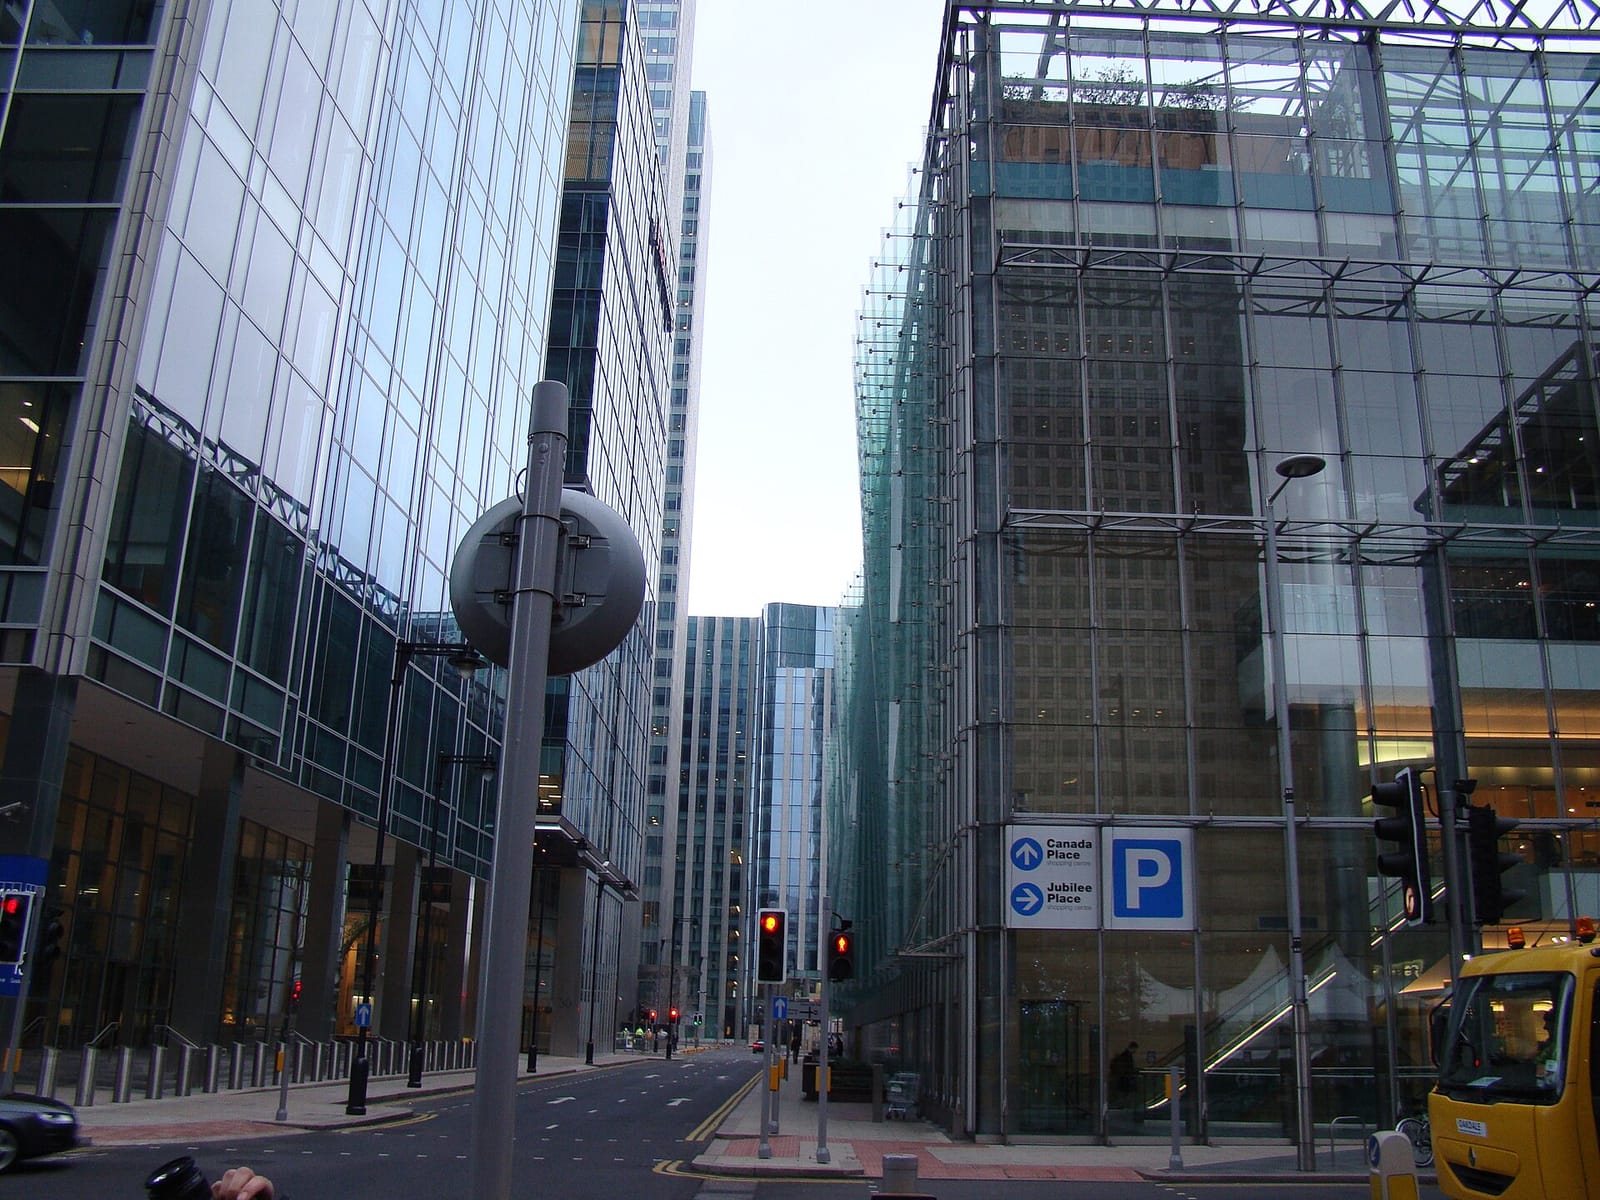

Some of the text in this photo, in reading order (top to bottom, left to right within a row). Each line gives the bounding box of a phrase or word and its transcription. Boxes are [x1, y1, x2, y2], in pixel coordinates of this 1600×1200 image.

[1046, 839, 1092, 849] Canada
[1047, 850, 1081, 859] Place
[1126, 848, 1171, 909] P
[1047, 882, 1092, 893] Jubilee
[1047, 894, 1081, 903] Place
